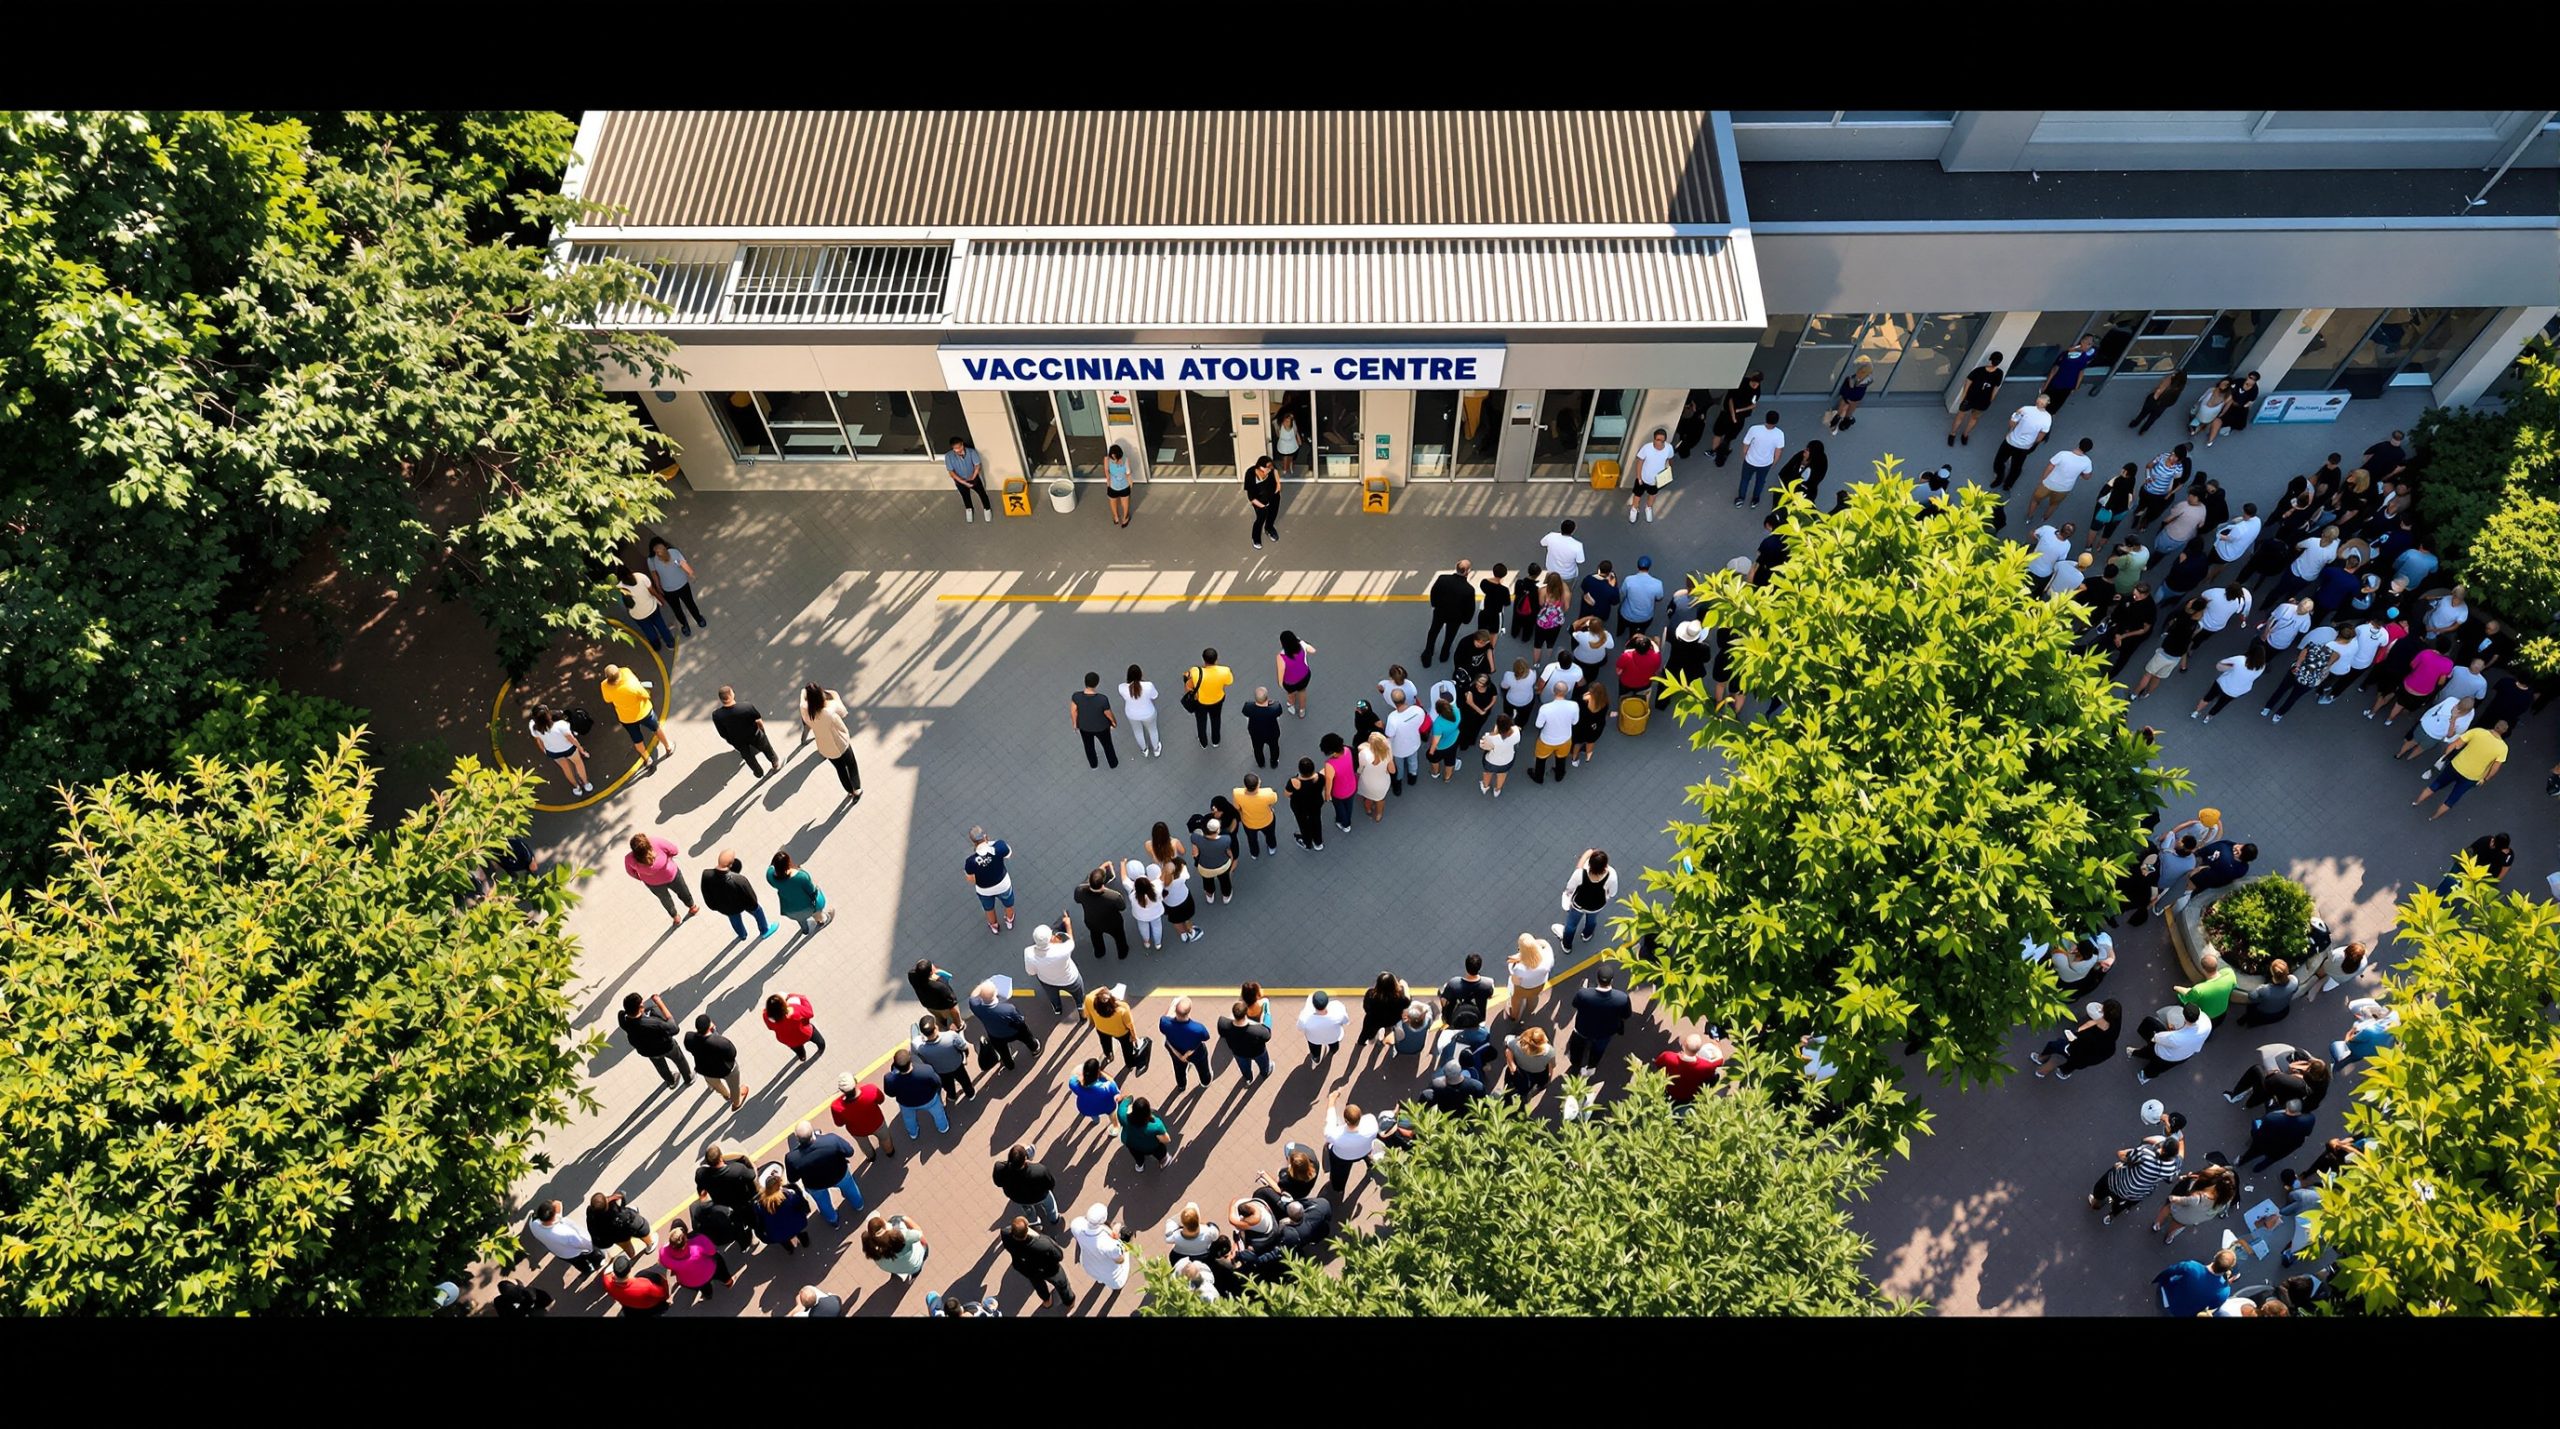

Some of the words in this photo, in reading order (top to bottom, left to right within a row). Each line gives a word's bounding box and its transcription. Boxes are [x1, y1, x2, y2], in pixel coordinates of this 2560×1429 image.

[963, 358, 1165, 381] VACCINIAN
[1179, 358, 1300, 381] ATOUR
[1333, 358, 1477, 381] CENTRE
